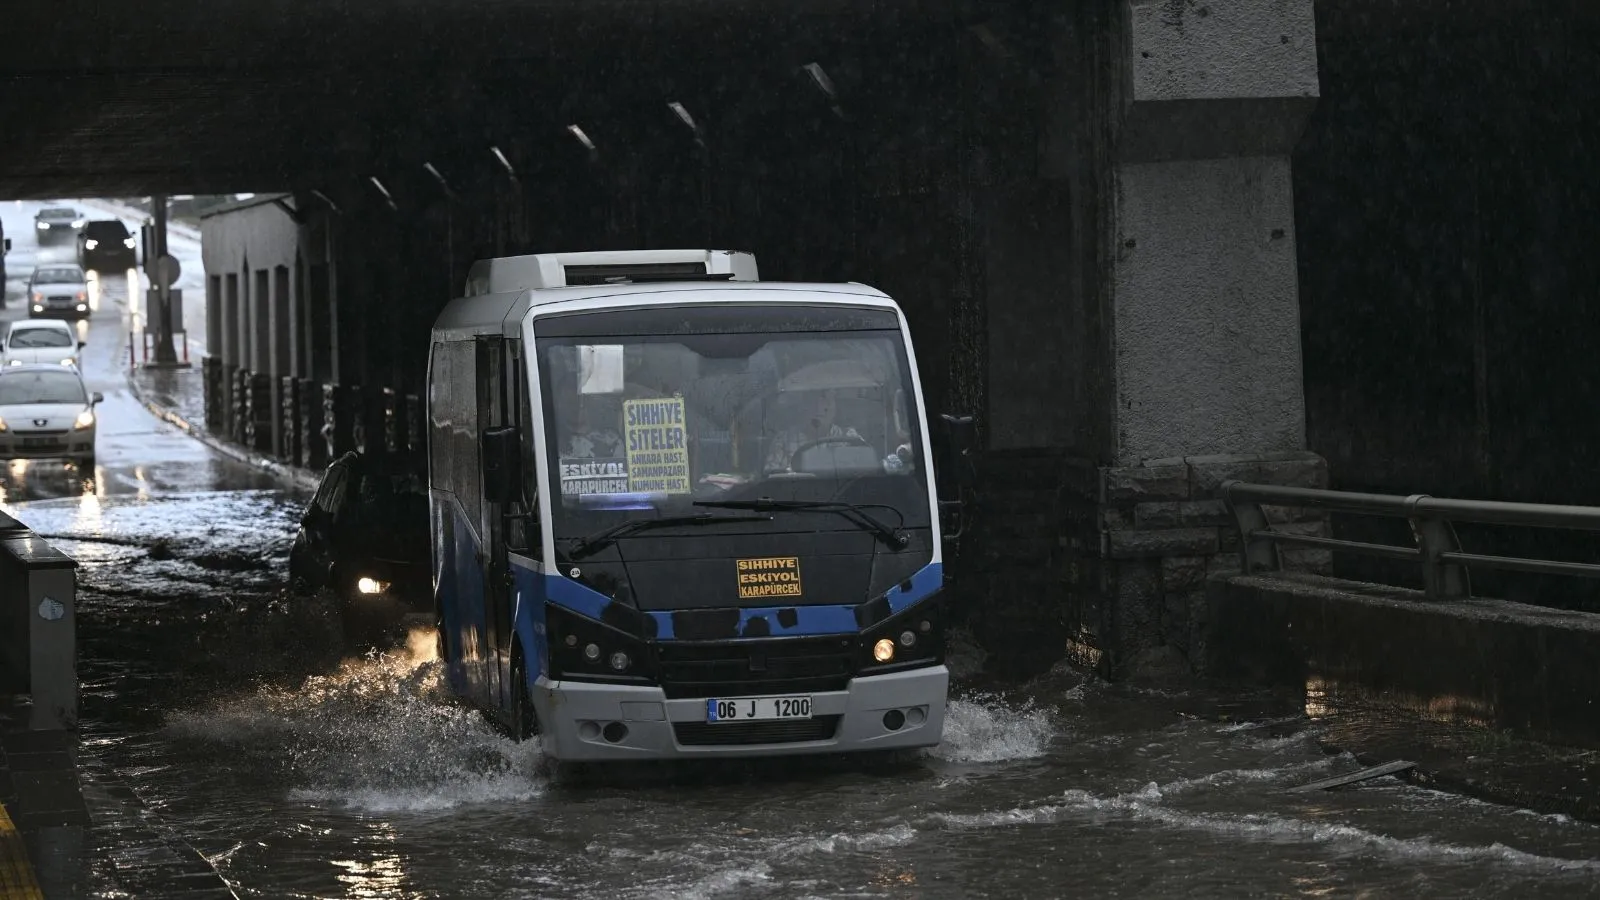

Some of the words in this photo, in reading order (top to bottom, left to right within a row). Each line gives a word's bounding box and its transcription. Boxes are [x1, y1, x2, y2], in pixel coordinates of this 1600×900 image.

[631, 453, 662, 465] ANKARA
[632, 480, 665, 492] NUMUNE
[718, 701, 736, 718] 06
[747, 700, 756, 717] J
[774, 699, 809, 717] 1200
